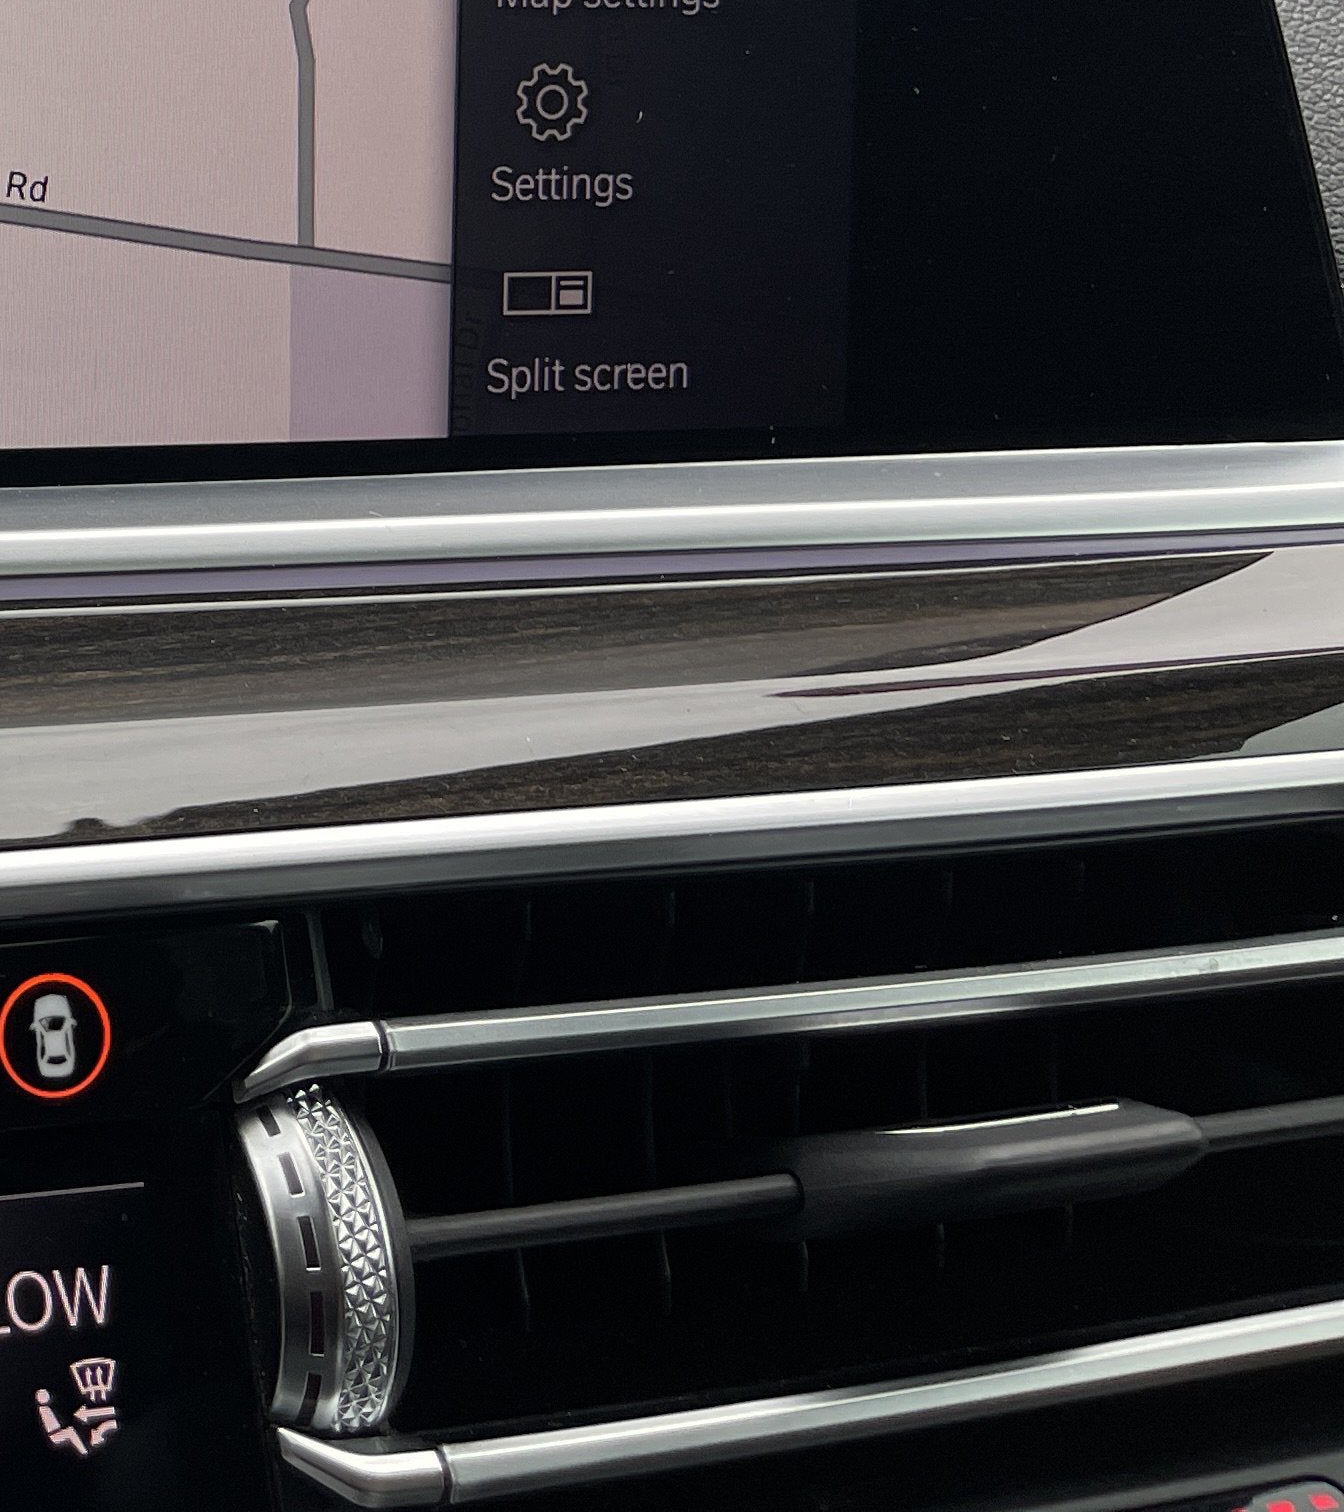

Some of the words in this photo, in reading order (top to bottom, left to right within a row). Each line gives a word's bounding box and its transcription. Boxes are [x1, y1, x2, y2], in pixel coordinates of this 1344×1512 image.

[6, 171, 49, 203] Rd
[491, 165, 634, 207] Settings
[486, 357, 566, 400] Split
[574, 360, 689, 391] screen
